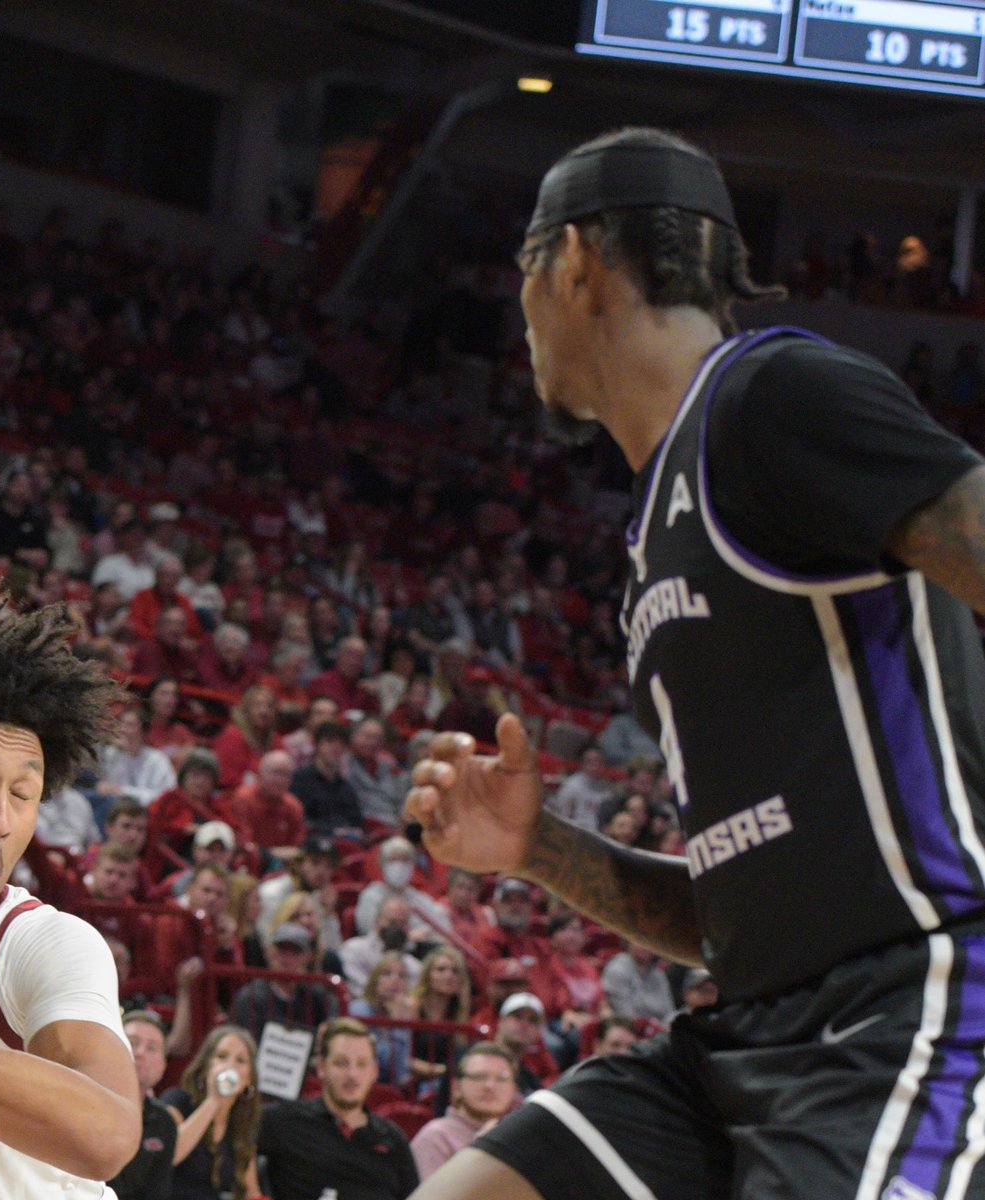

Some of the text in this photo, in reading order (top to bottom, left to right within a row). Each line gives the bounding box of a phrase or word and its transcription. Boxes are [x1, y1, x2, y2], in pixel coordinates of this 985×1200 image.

[666, 8, 767, 47] 15 PTS
[865, 29, 968, 69] 10 PTS
[687, 795, 794, 880] NSAS
